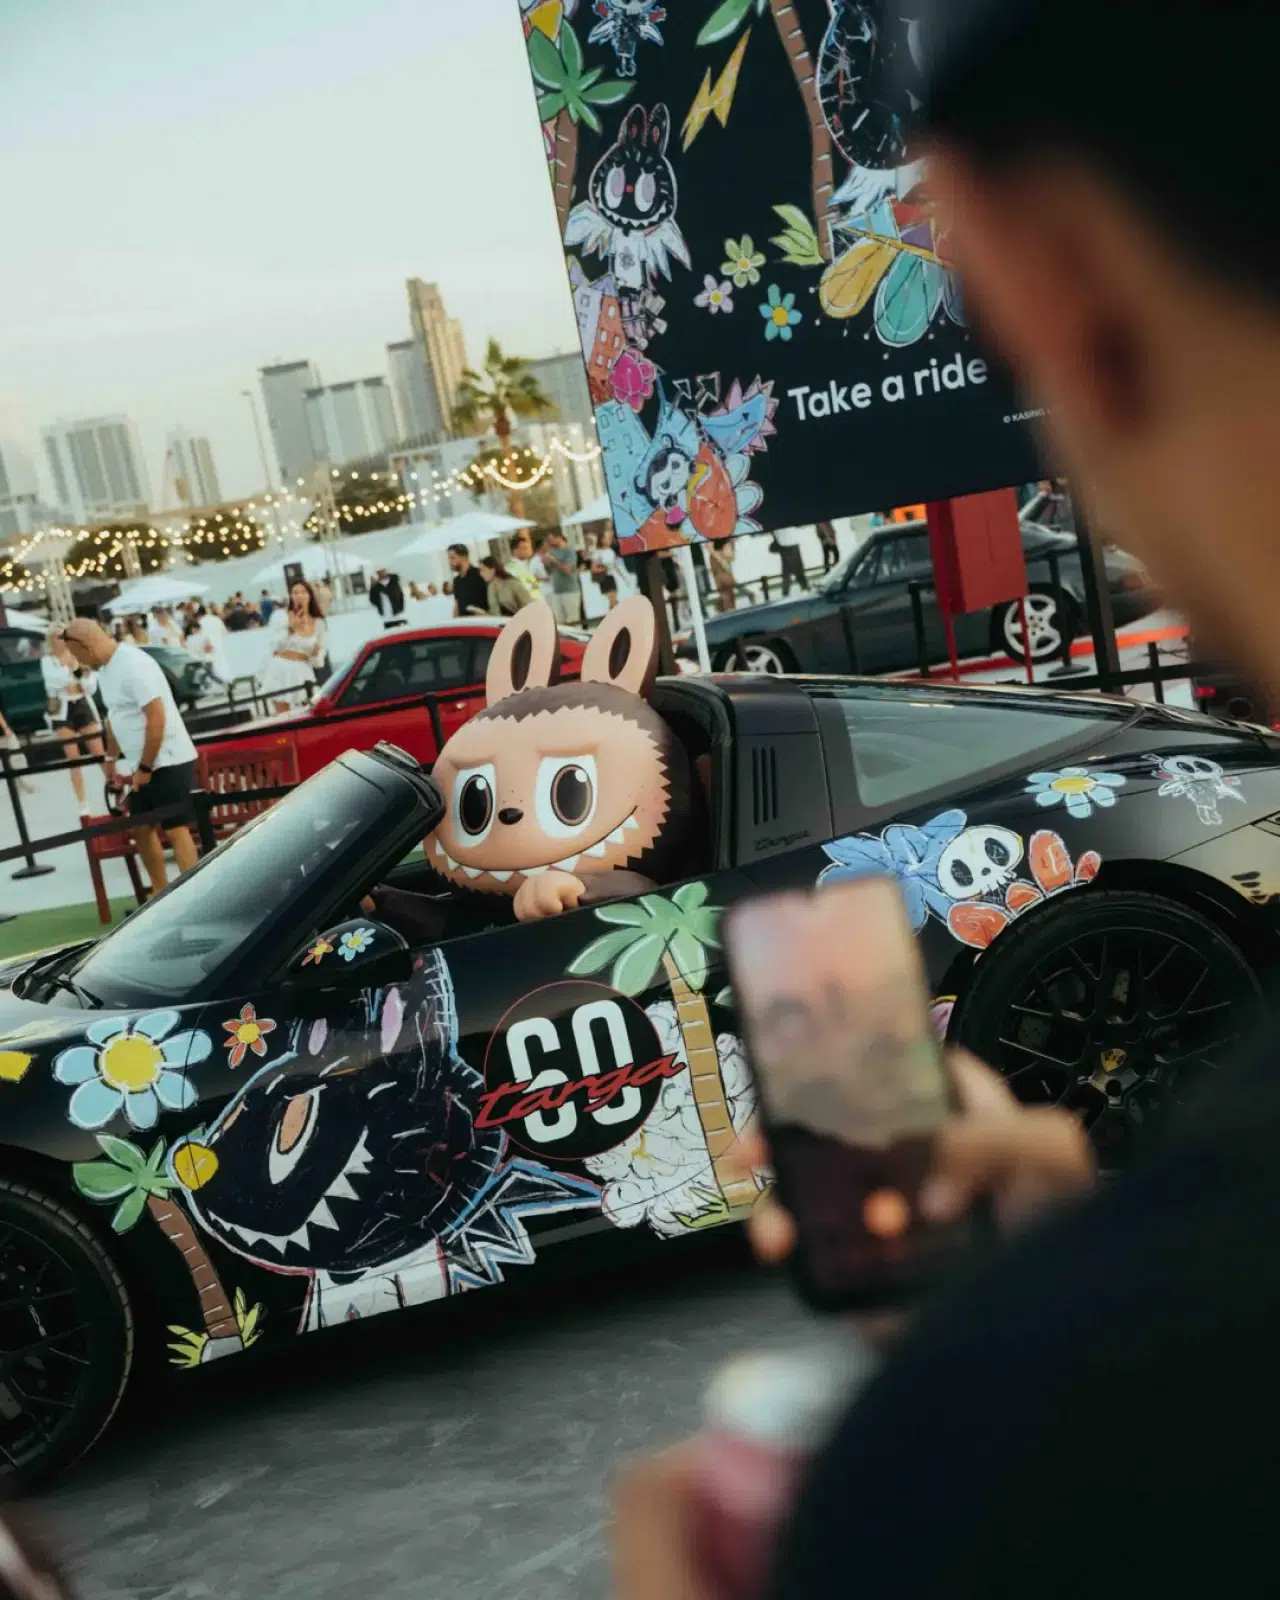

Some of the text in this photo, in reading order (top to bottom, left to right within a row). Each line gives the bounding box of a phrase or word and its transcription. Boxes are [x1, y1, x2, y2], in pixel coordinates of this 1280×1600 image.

[787, 352, 988, 421] Take a ride
[474, 1052, 687, 1128] targa
[506, 1000, 642, 1143] 60
